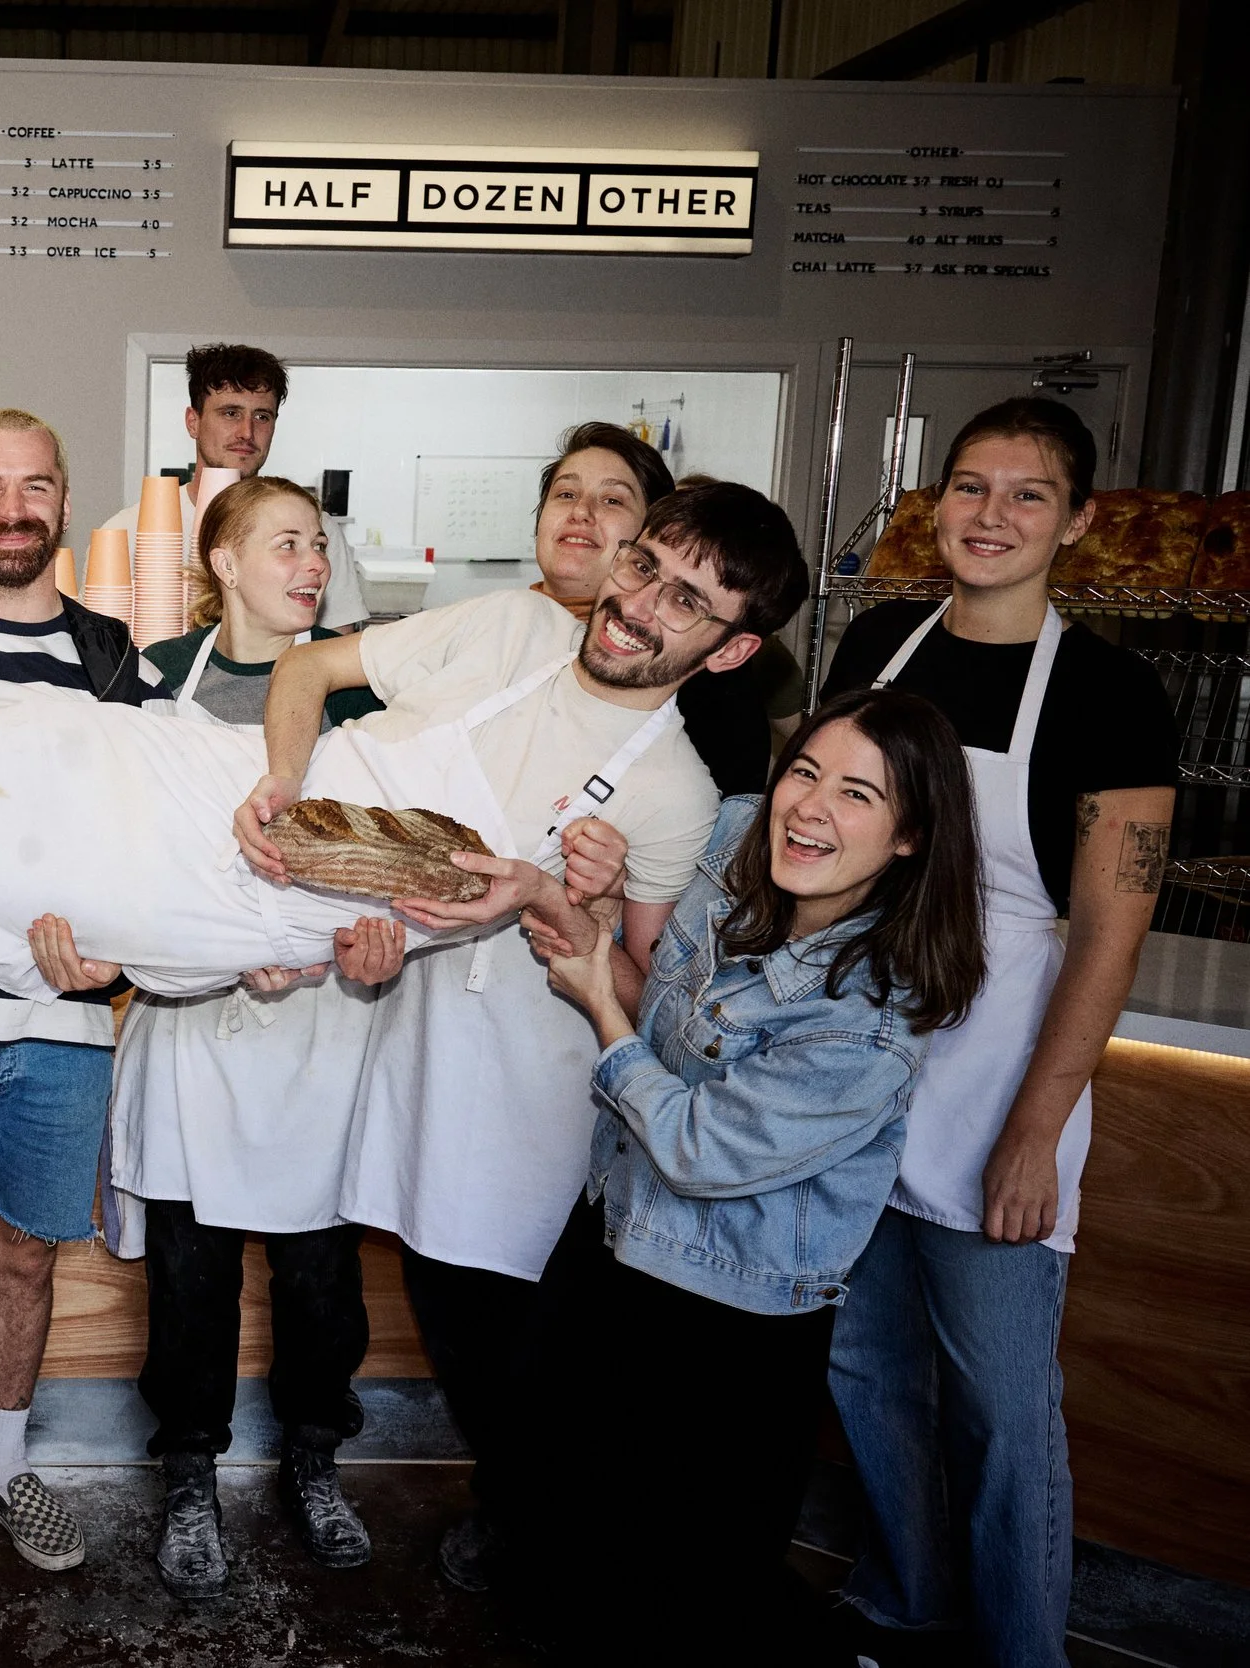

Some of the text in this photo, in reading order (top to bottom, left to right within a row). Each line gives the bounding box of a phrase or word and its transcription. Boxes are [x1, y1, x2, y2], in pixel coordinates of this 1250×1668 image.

[52, 158, 93, 169] LATTE
[797, 174, 827, 186] HOT
[832, 175, 907, 186] CHOCOLATE
[940, 176, 978, 186] FRESH
[985, 177, 1004, 190] OJ
[49, 187, 131, 199] CAPPUCCINO
[265, 181, 735, 215] HALF DOZEN OTHER
[797, 203, 830, 214] TEAS
[939, 206, 983, 217] SYRUPS
[48, 217, 97, 227] MOCHA
[794, 232, 845, 243] MATCHA
[933, 235, 960, 246] ALT
[966, 235, 1003, 246] MILKS
[47, 247, 80, 257] OVER
[94, 248, 117, 259] ICE
[793, 262, 826, 272] CHAI
[837, 263, 875, 273] LATTE
[930, 264, 1049, 277] ASK FOR SPECIALS
